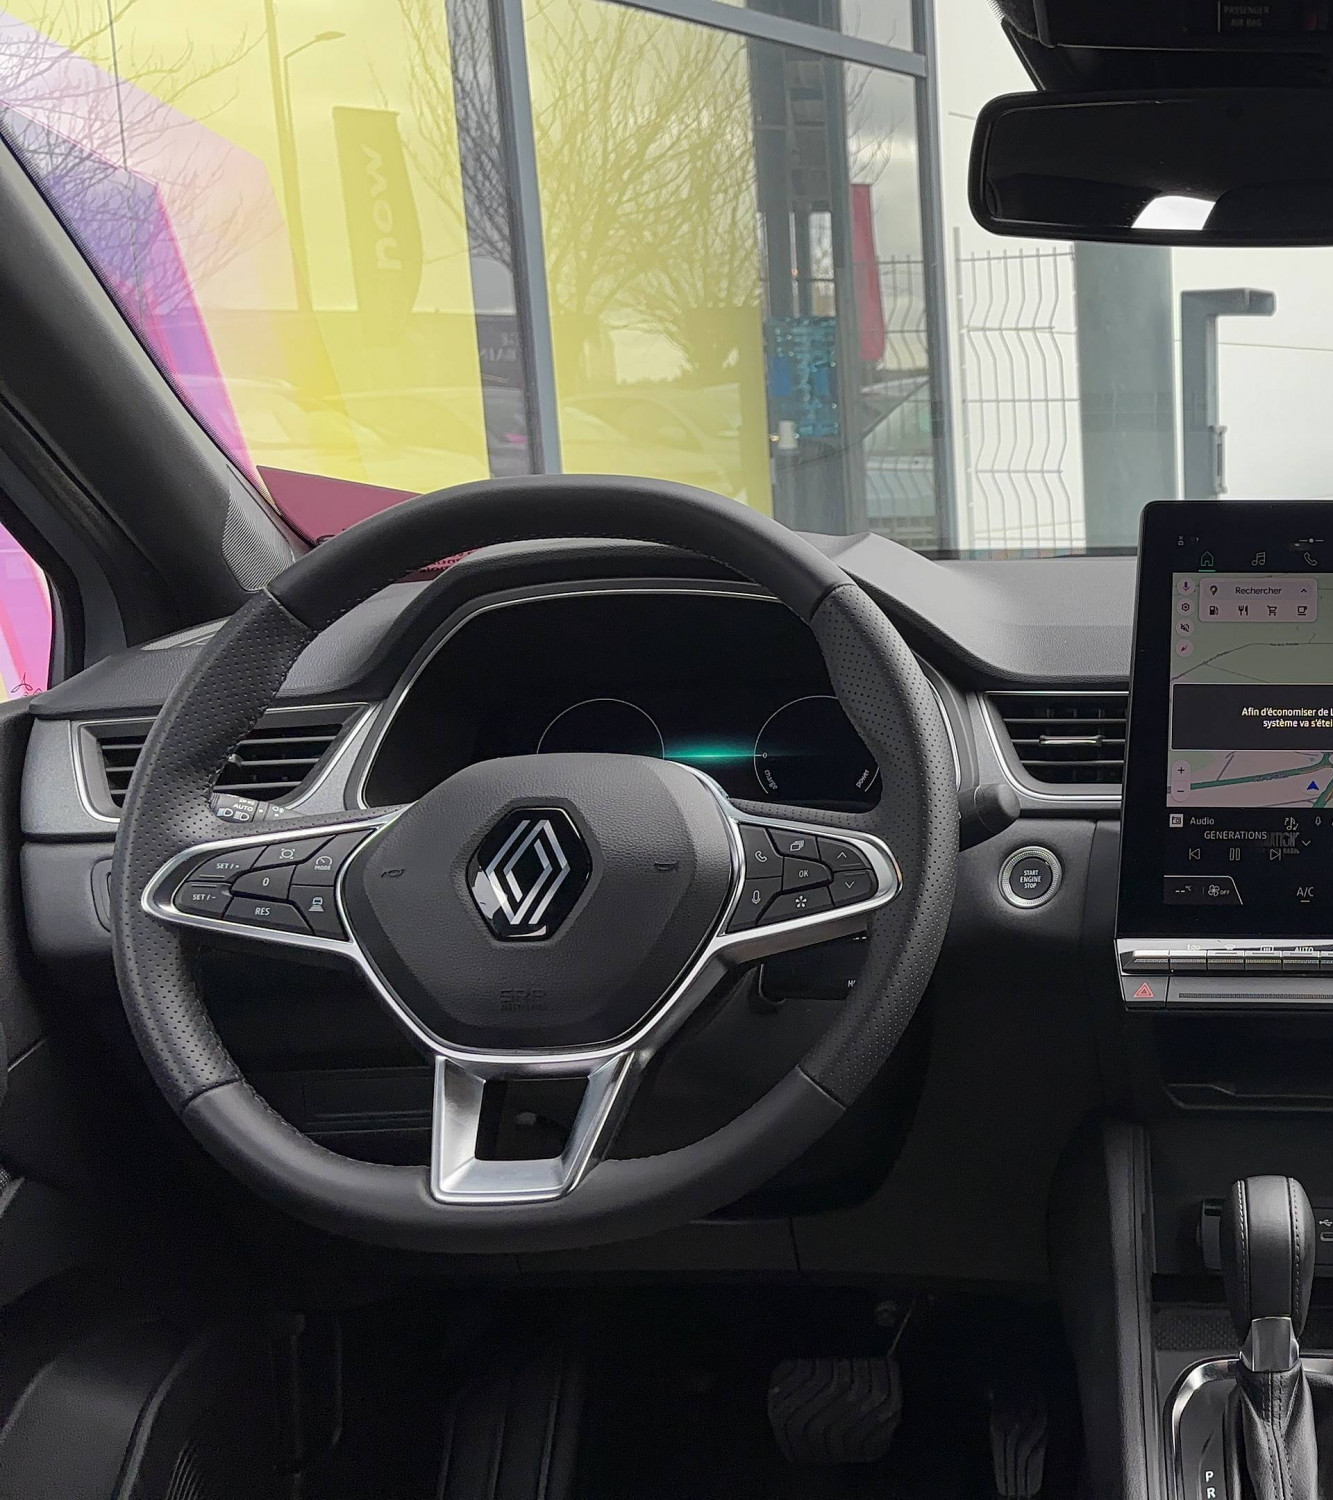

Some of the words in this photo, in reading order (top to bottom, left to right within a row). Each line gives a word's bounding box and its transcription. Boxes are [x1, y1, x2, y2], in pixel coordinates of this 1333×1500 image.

[1223, 5, 1270, 15] PASSENGER
[1234, 586, 1282, 595] Rechercher
[1241, 707, 1259, 716] Afin
[1260, 707, 1317, 716] d'économiser
[1317, 707, 1328, 716] de
[1263, 719, 1298, 729] système
[763, 768, 779, 791] charge
[855, 768, 870, 789] power
[233, 803, 254, 812] AUTO
[1190, 816, 1215, 825] Audio
[1203, 831, 1268, 840] GENERATIONS
[798, 870, 809, 878] OK
[1020, 875, 1042, 883] ENGINE
[1296, 886, 1315, 897] A/C
[254, 907, 271, 916] RES
[1205, 1470, 1213, 1482] P
[1207, 1487, 1216, 1499] R
